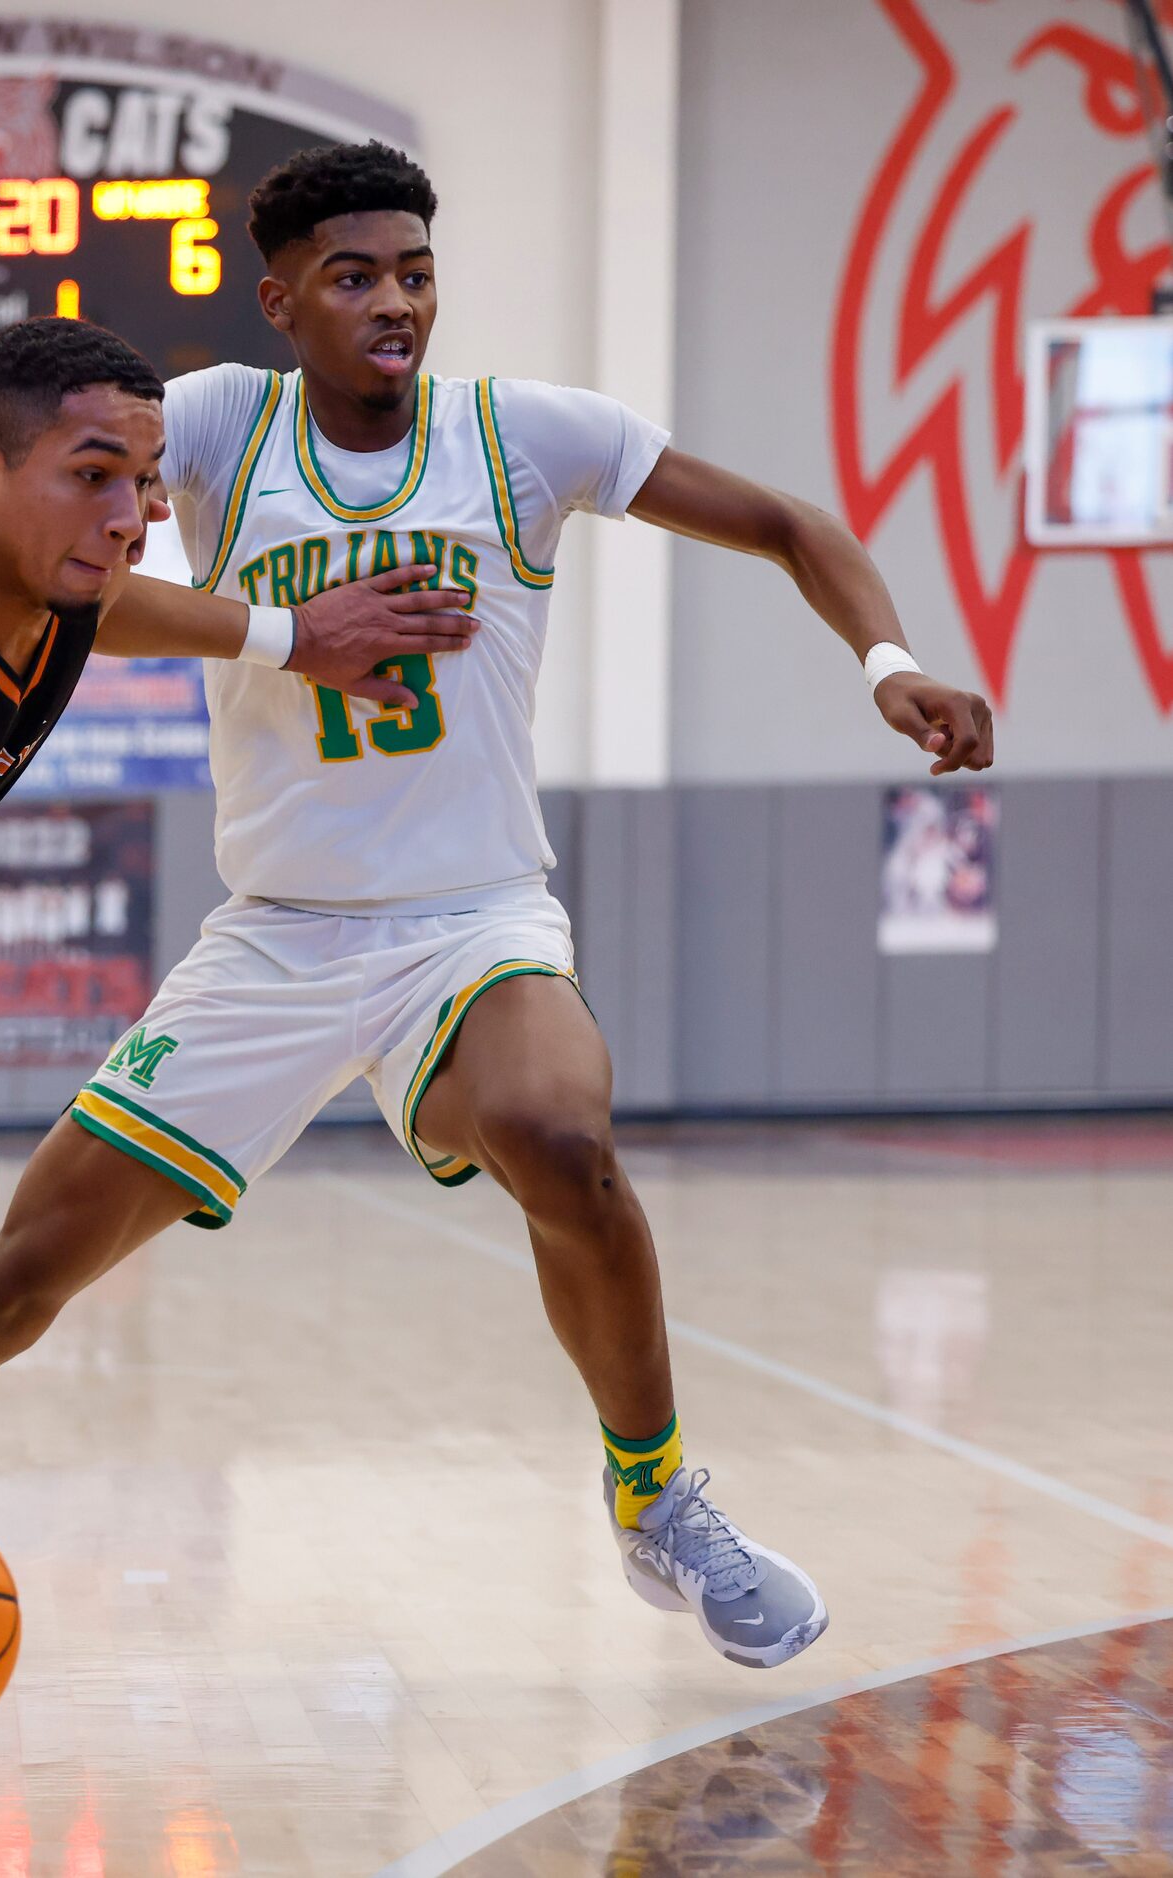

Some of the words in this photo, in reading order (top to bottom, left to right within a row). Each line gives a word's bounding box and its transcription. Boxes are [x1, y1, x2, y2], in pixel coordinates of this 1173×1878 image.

[42, 21, 283, 94] WILSON
[58, 86, 233, 180] CATS
[170, 218, 221, 295] 6
[237, 530, 480, 614] TROJANS
[304, 652, 446, 763] 13
[104, 1025, 180, 1090] M
